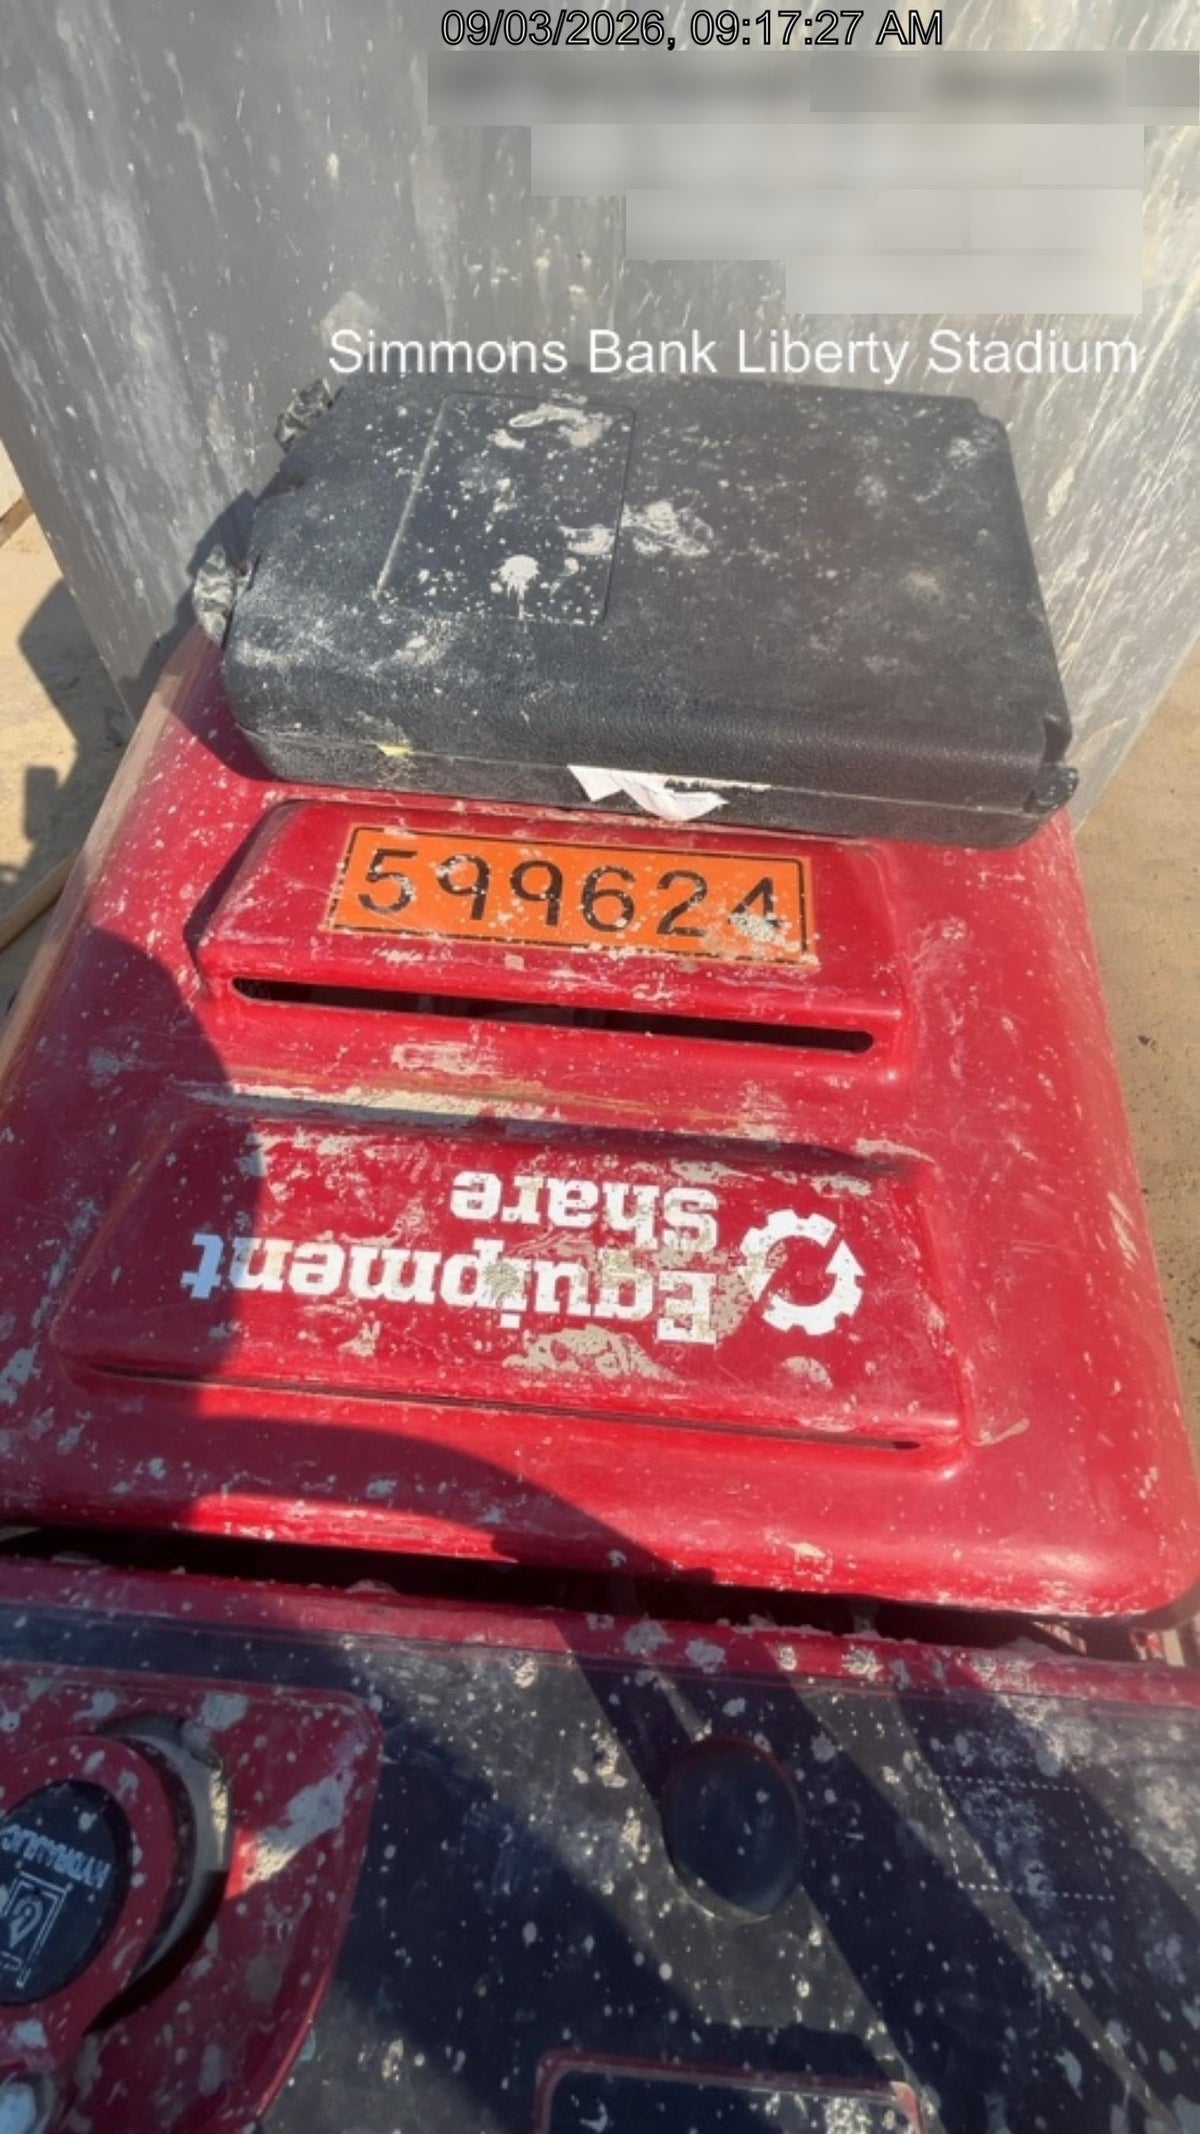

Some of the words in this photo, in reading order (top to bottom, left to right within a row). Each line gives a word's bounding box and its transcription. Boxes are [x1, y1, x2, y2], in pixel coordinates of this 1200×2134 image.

[357, 848, 786, 938] 599624
[452, 1171, 720, 1252] Share
[180, 1231, 717, 1344] Equipment
